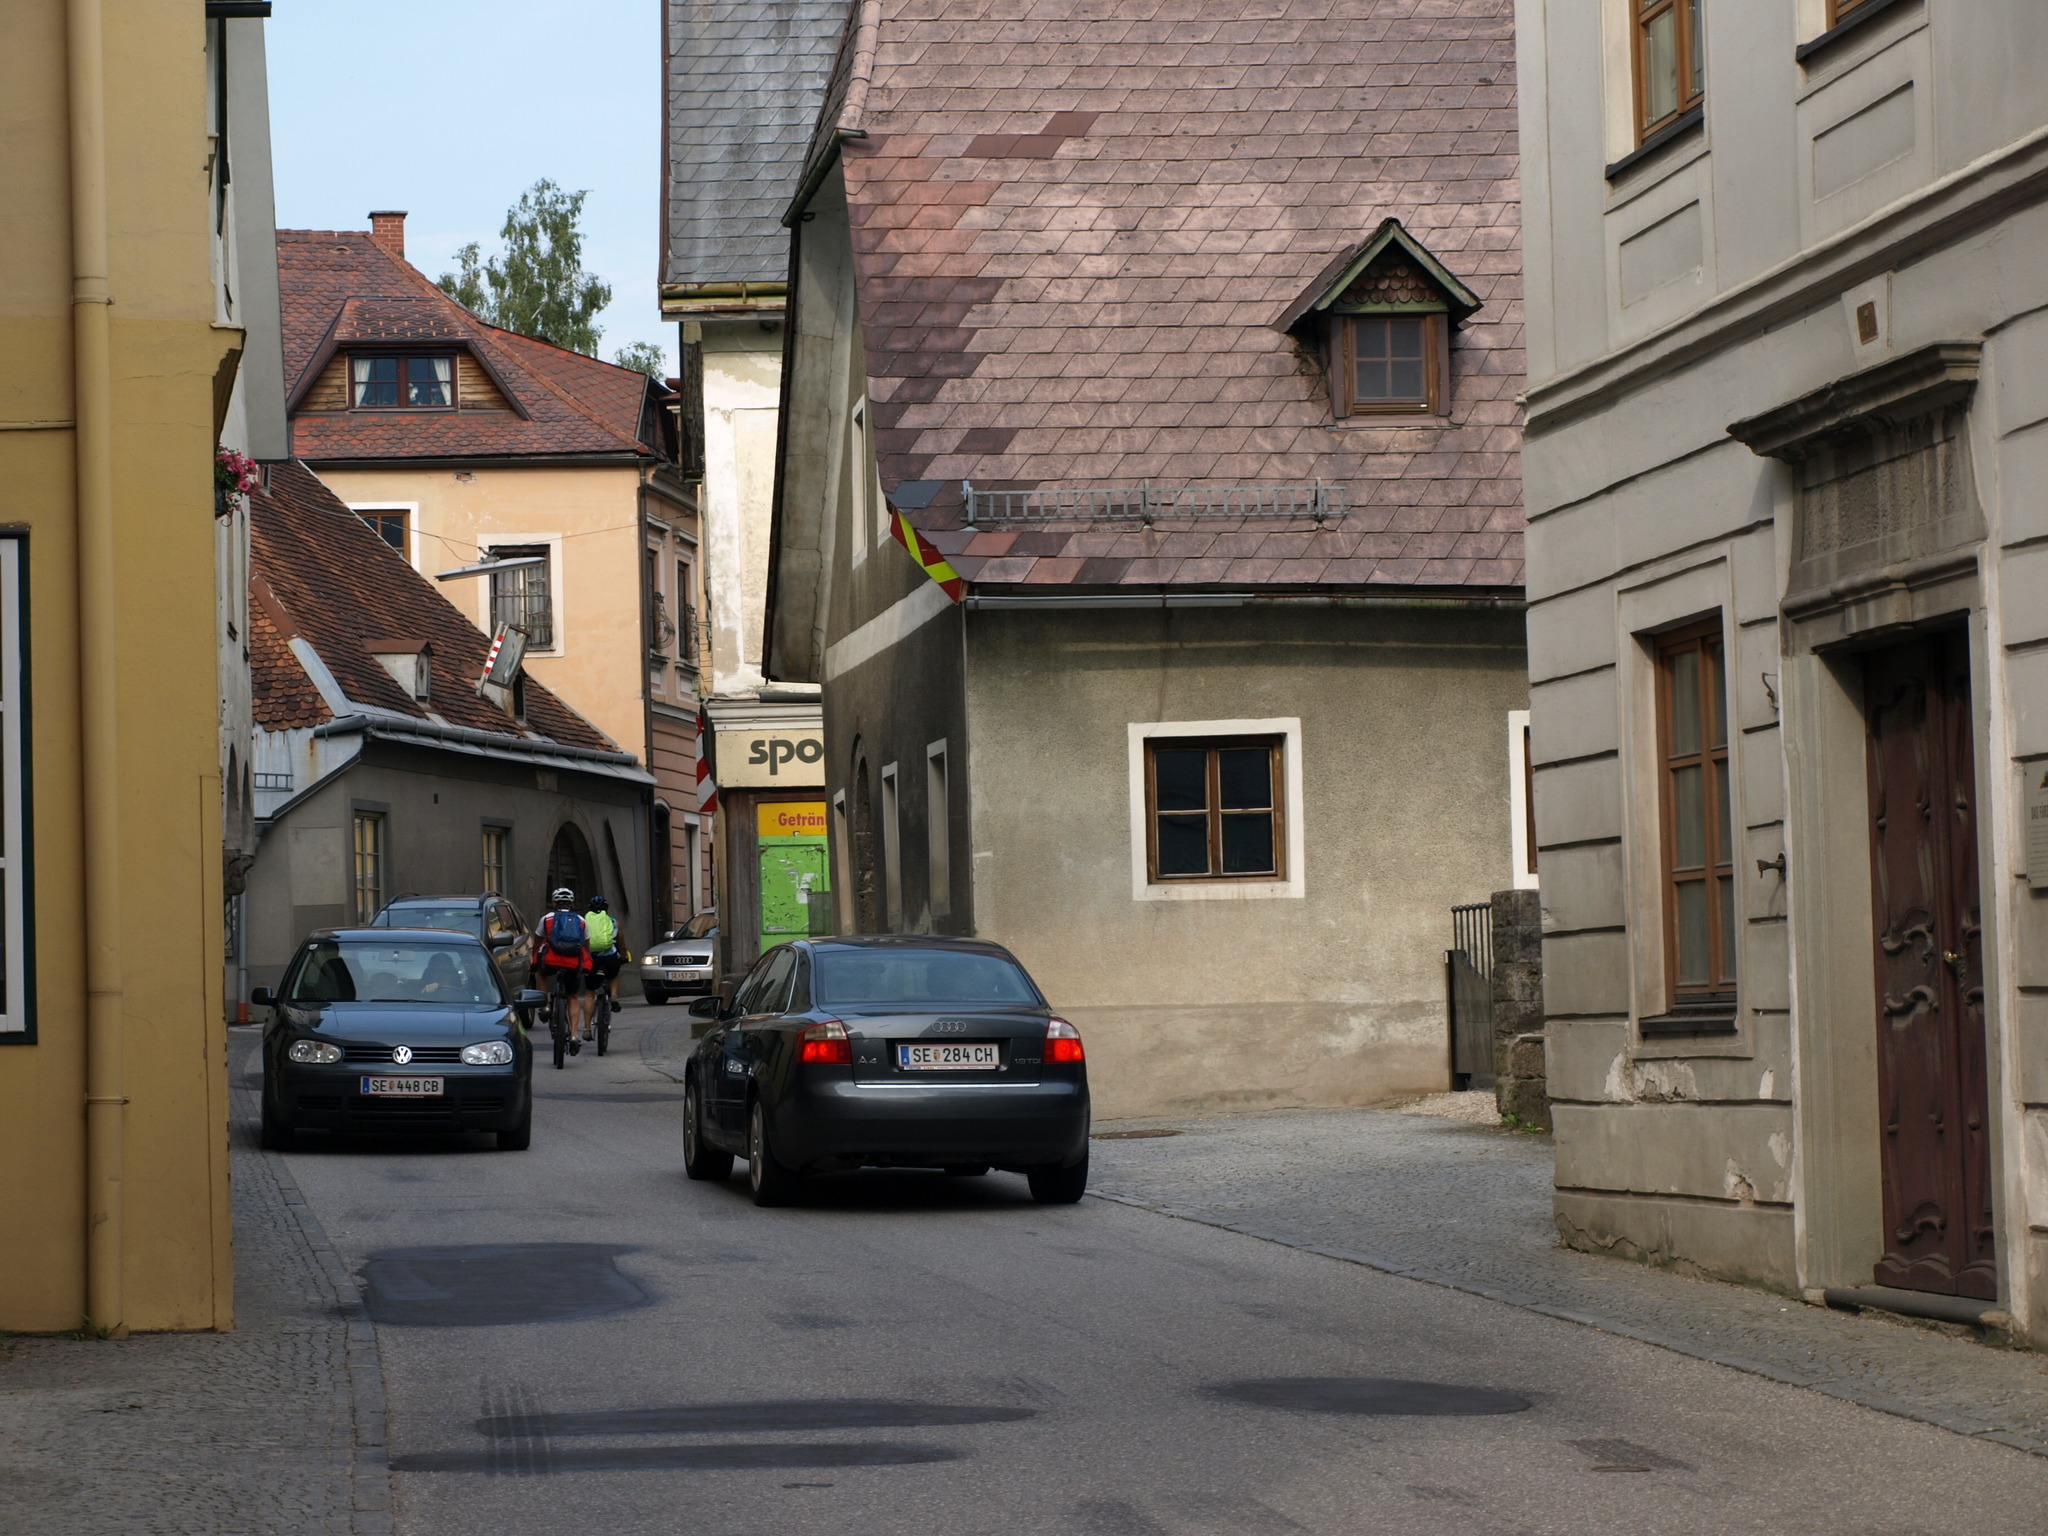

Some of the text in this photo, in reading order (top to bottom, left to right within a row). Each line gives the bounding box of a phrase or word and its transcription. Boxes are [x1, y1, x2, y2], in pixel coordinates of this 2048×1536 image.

[778, 812, 828, 826] Geträn
[913, 1048, 931, 1062] SE
[943, 1047, 971, 1062] 284
[974, 1047, 993, 1062] CH
[372, 1080, 439, 1092] SE 448 CB
